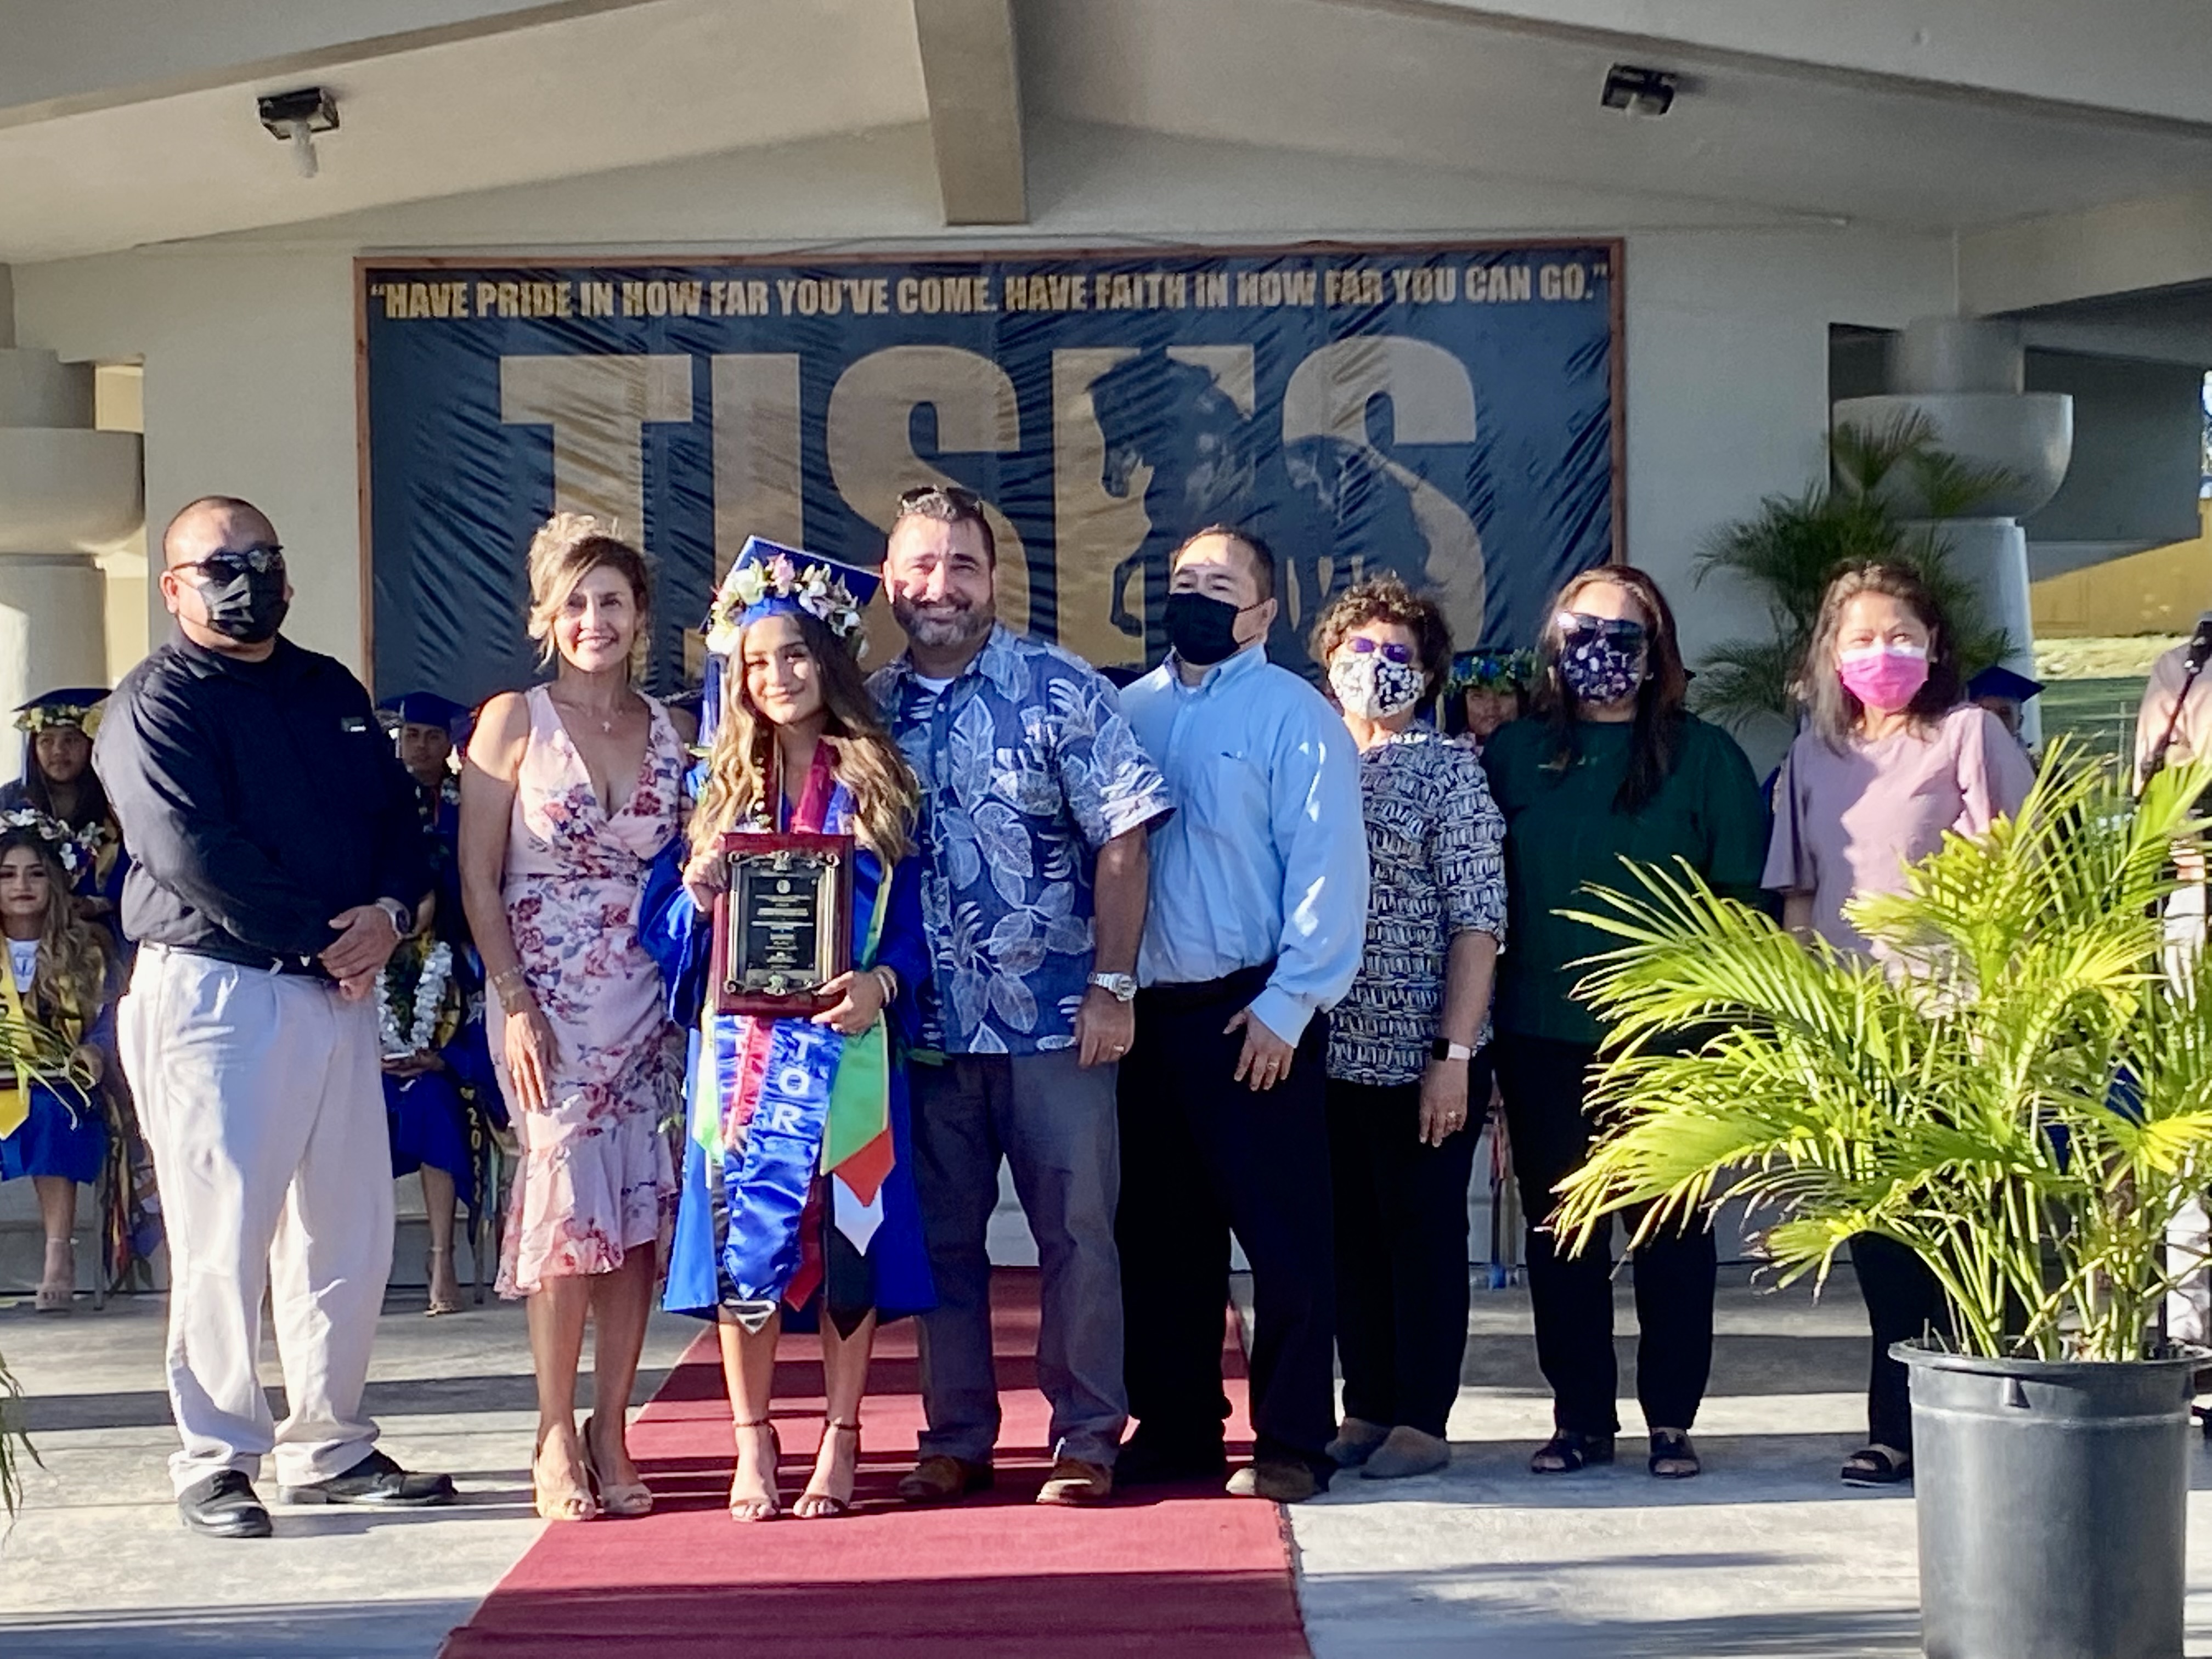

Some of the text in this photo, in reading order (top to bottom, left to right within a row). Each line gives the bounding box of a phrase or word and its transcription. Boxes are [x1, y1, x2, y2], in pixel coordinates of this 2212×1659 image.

[476, 281, 572, 317] PRIDE
[579, 281, 614, 317] IN
[622, 281, 702, 317] HOW
[709, 280, 769, 315] FAR
[777, 278, 889, 315] YOU'VE
[896, 276, 997, 313] COME.
[1005, 275, 1089, 311] HAVE
[1096, 273, 1187, 311] FAITH
[1193, 273, 1231, 309] IN
[1236, 272, 1318, 307] HOW
[1323, 269, 1383, 305] FAR
[1391, 267, 1457, 304] YOU
[1464, 266, 1532, 302] CAN
